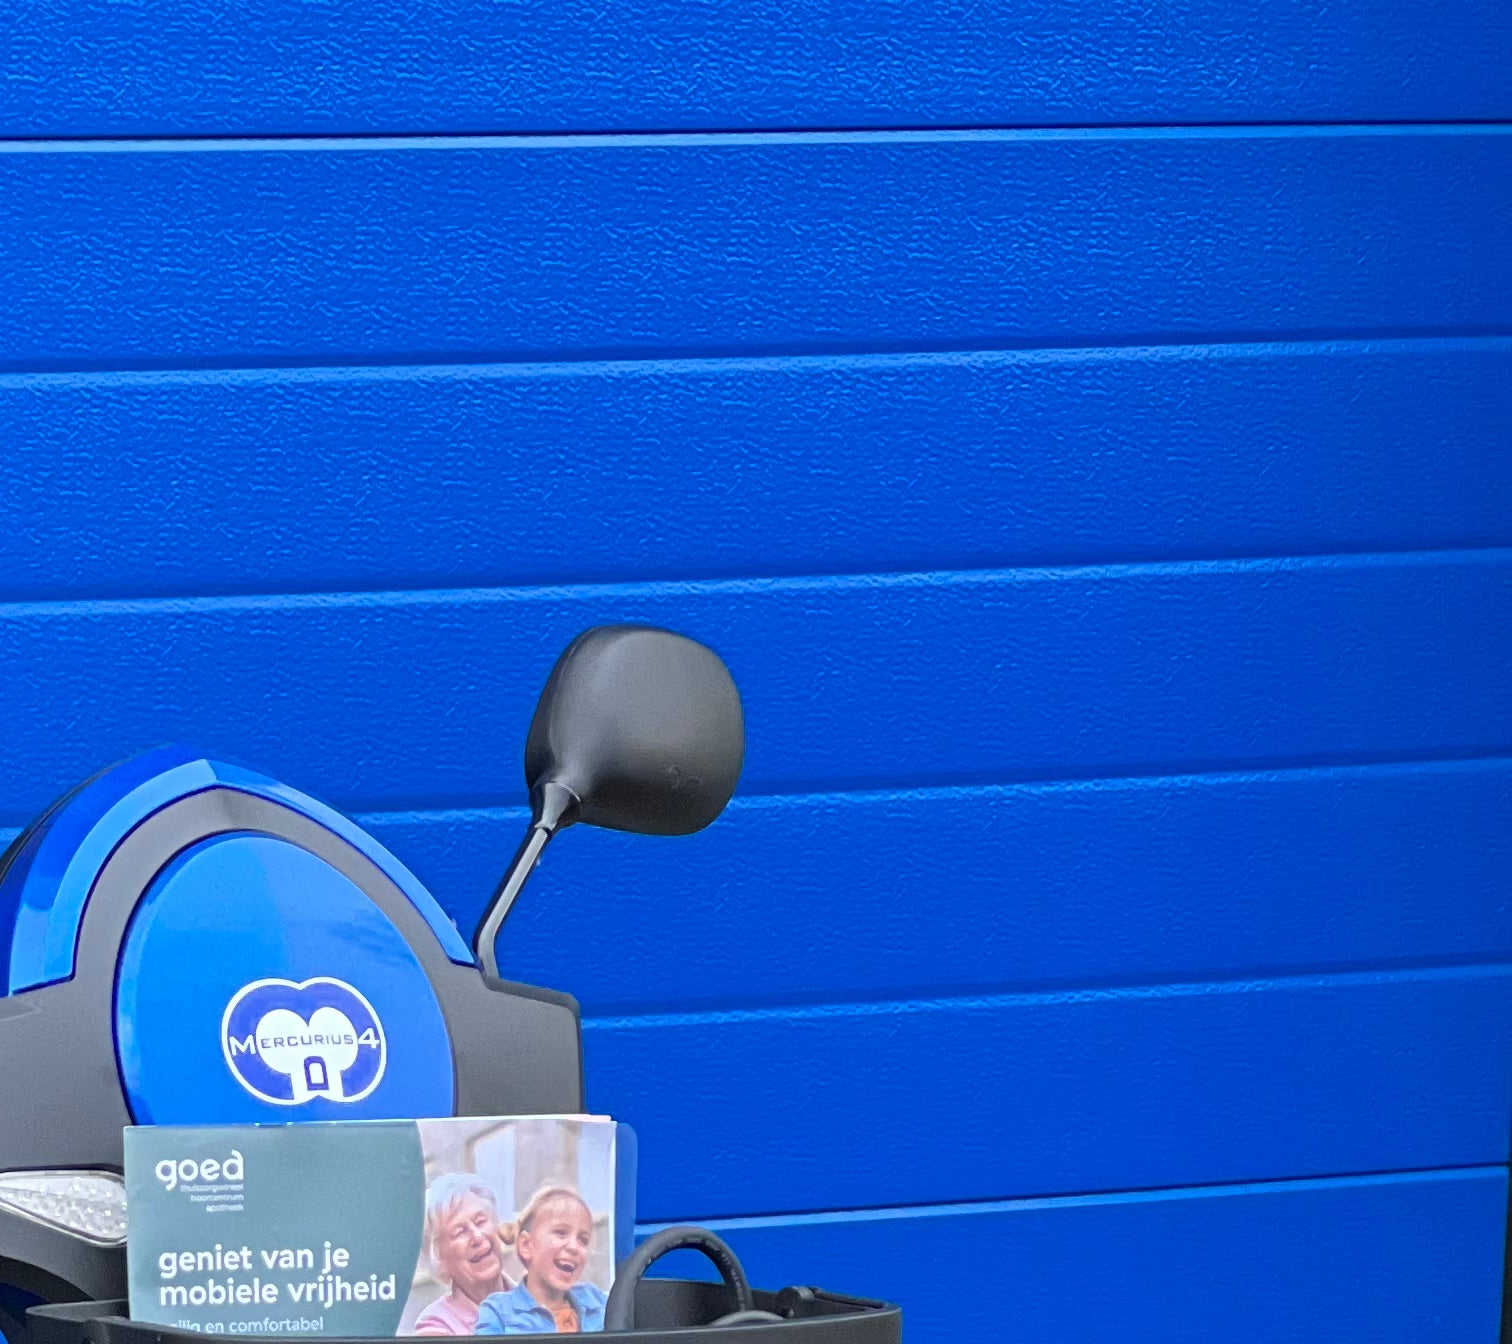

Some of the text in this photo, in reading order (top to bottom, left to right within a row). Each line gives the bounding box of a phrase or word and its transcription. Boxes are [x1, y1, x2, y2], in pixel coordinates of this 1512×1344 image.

[155, 1148, 245, 1191] goed
[158, 1240, 350, 1279] geniet van je
[159, 1273, 397, 1309] mobiele vrijheid
[205, 1322, 225, 1334] en
[229, 1315, 325, 1334] comfortabel
